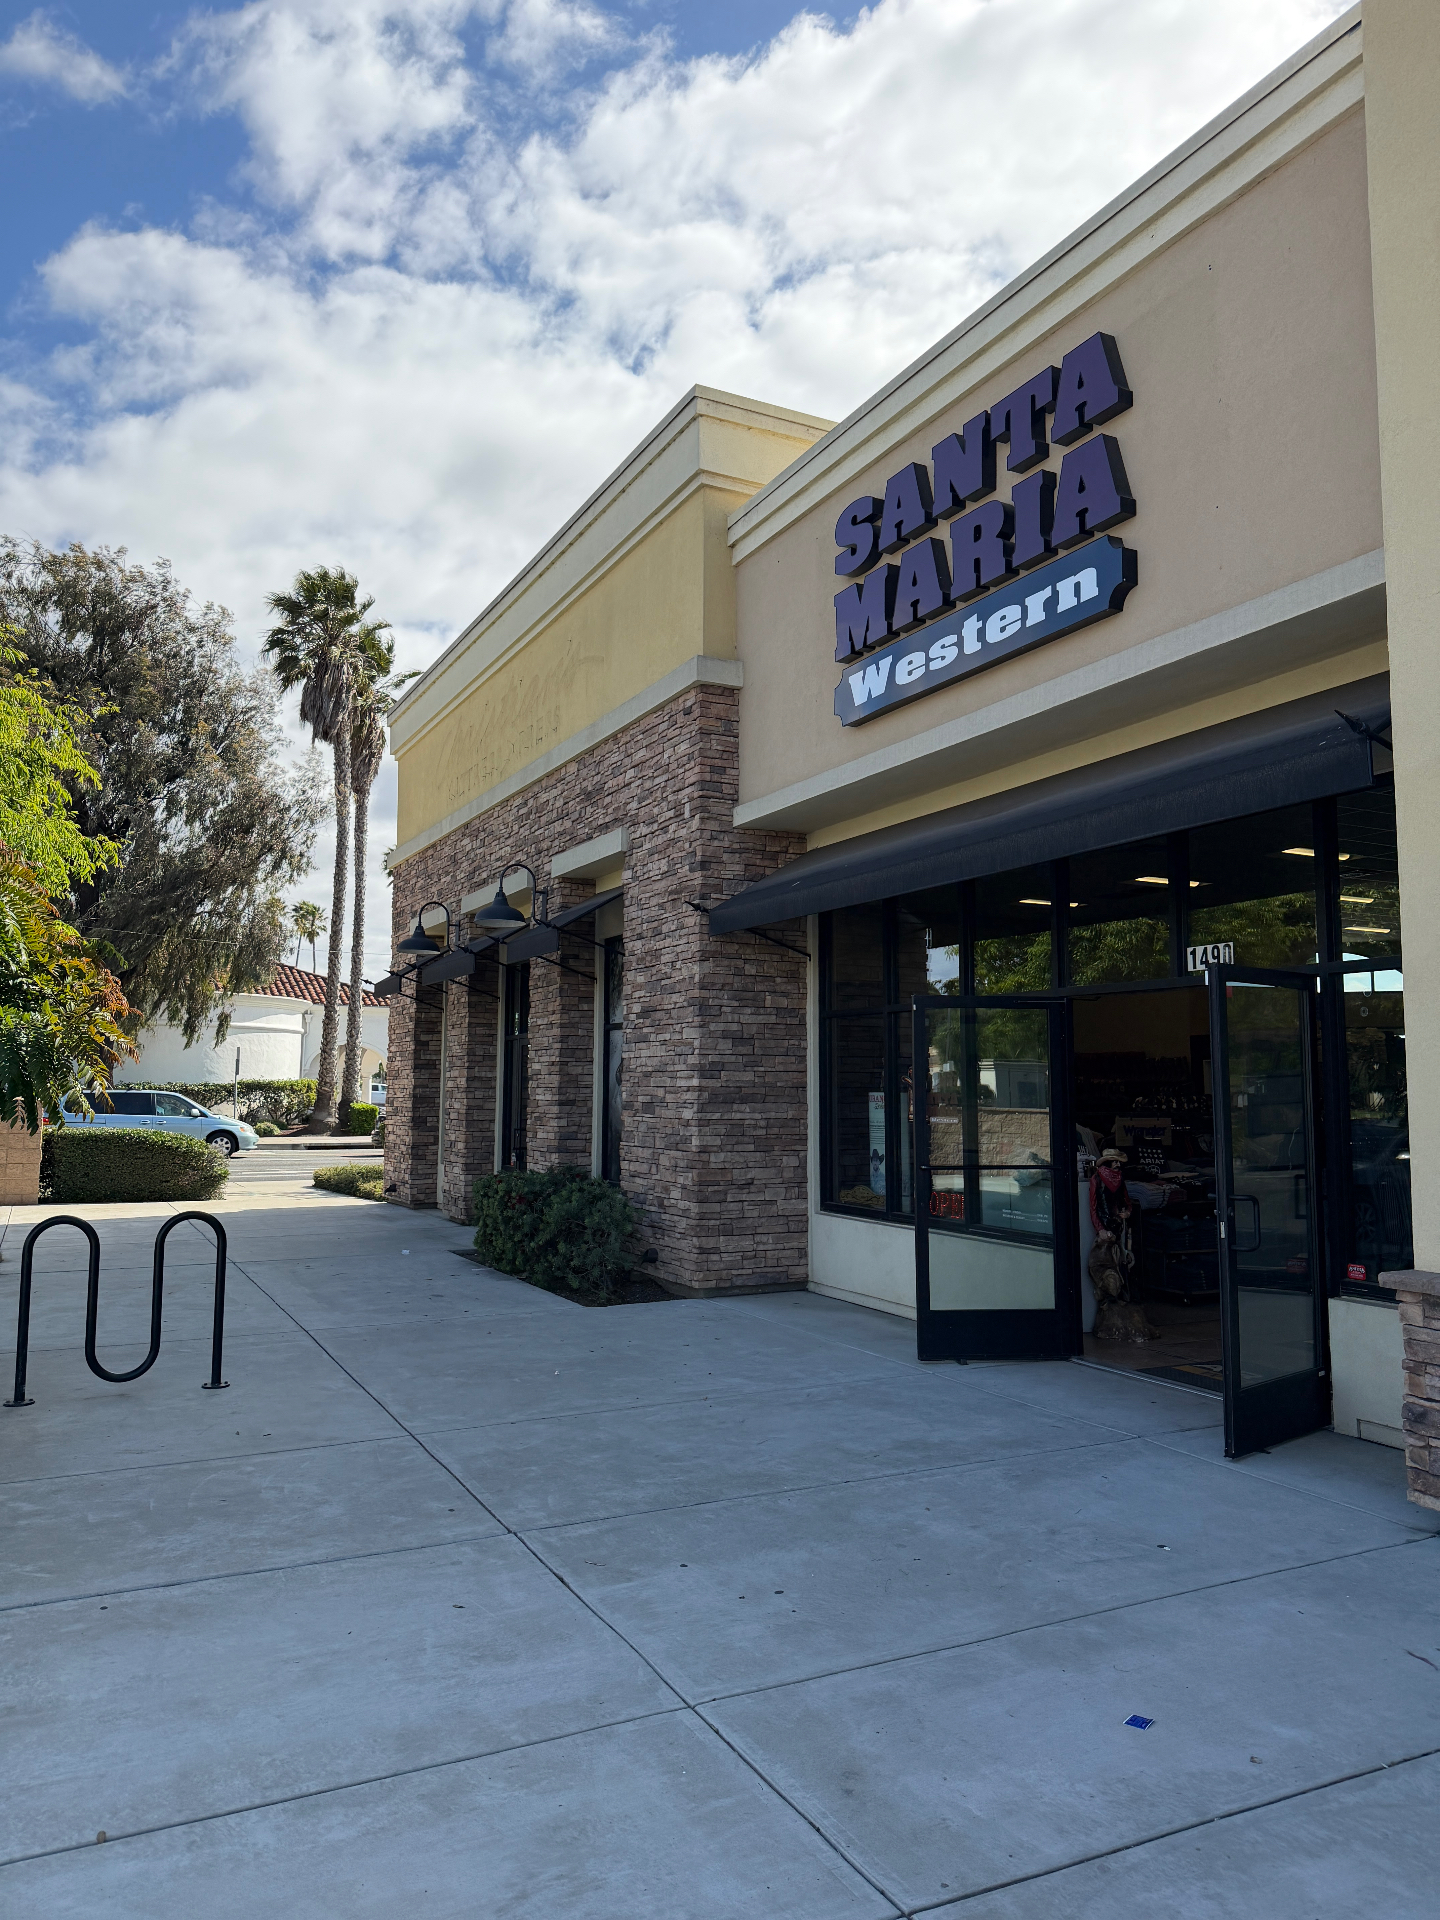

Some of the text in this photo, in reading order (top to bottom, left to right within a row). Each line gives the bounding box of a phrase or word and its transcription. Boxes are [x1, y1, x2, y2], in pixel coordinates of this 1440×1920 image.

[835, 331, 1128, 577] SANTA
[834, 433, 1131, 663] MARIA
[848, 566, 1099, 706] Western
[1189, 943, 1232, 970] 1490
